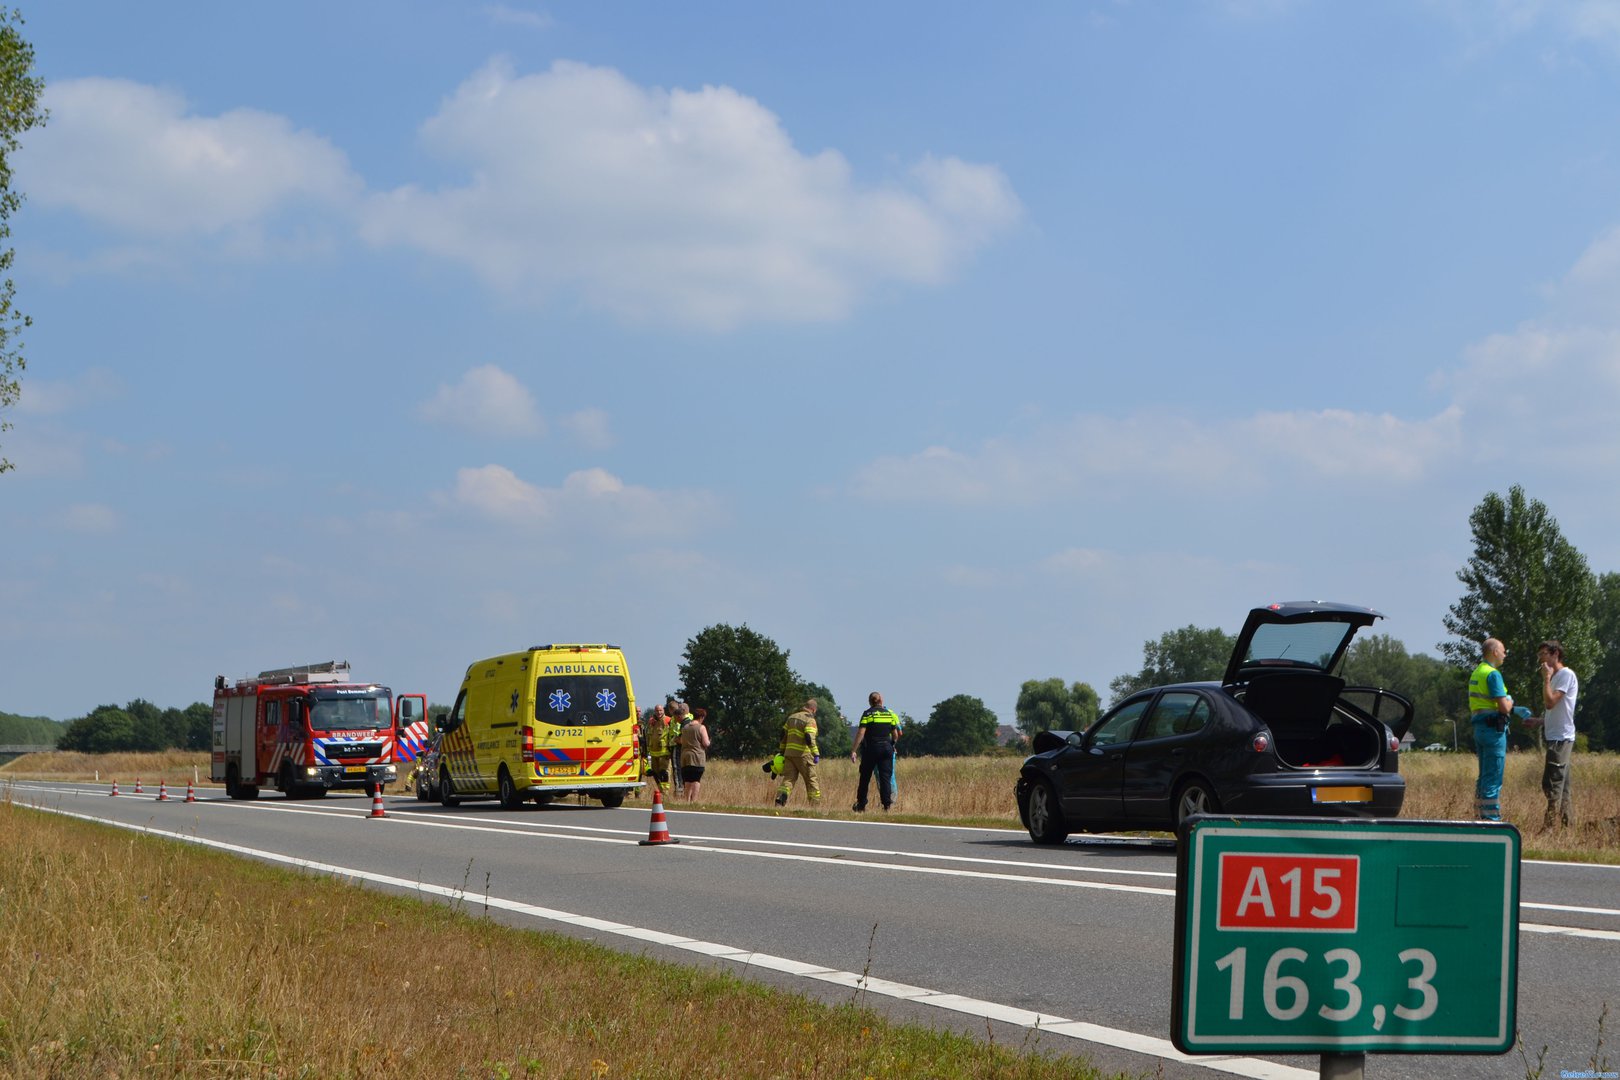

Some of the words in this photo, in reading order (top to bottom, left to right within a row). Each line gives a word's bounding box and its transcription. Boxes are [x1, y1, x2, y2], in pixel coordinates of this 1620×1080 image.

[544, 665, 620, 674] AMBULANCE
[554, 728, 583, 737] 07122
[1236, 866, 1342, 919] A15
[1214, 946, 1440, 1032] 163,3
